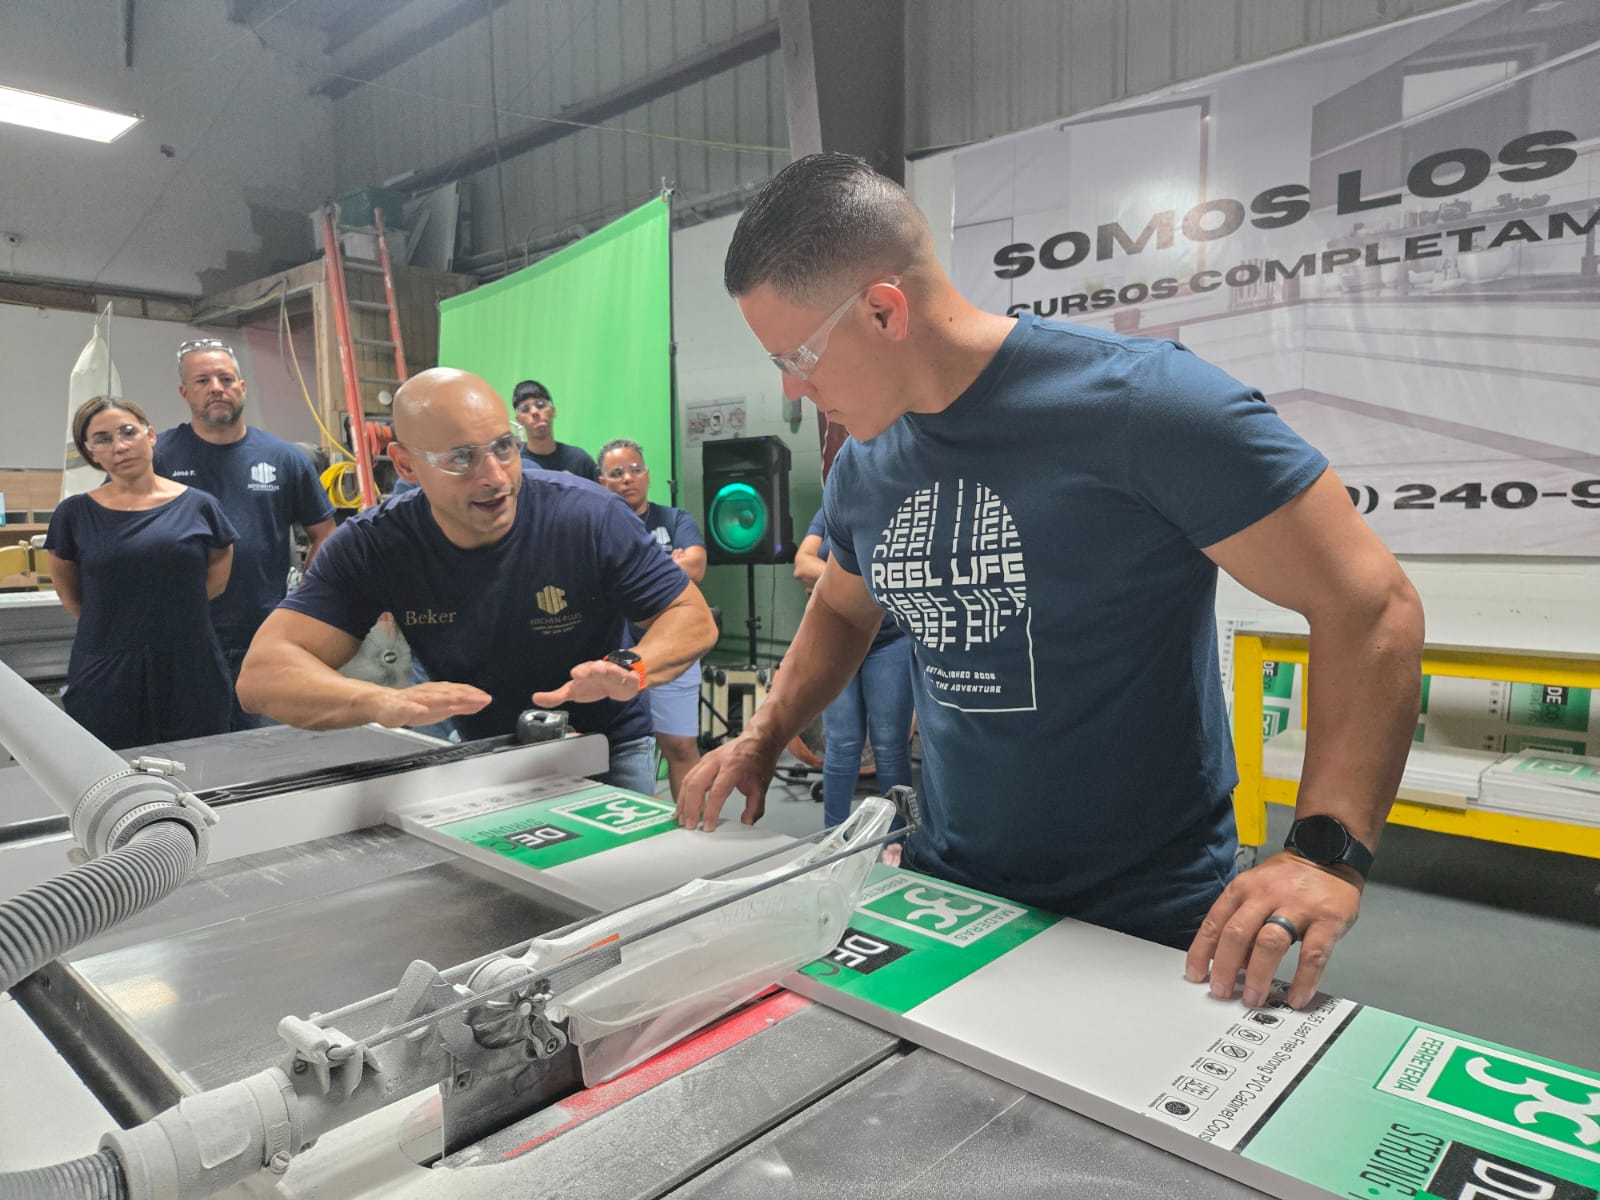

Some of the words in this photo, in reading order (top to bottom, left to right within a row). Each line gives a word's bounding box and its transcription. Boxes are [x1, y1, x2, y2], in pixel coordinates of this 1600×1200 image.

[993, 184, 1311, 280] SOMOS
[1337, 129, 1578, 217] LOS
[1006, 277, 1178, 318] CURSOS
[1189, 208, 1600, 293] COMPLETAM
[871, 560, 942, 589] REEL
[951, 552, 1026, 585] LIFE
[405, 608, 457, 626] Beker
[950, 683, 1002, 694] ADVENTURE
[954, 908, 1016, 942] MADERAS
[1280, 1036, 1305, 1052] Free
[1294, 1022, 1319, 1039] Lead
[1256, 1051, 1292, 1074] Strong
[1392, 1036, 1445, 1092] FERRETERIA
[1246, 1072, 1272, 1092] PVC
[1218, 1089, 1257, 1121] Cabinet
[1360, 1123, 1445, 1197] STRONG
